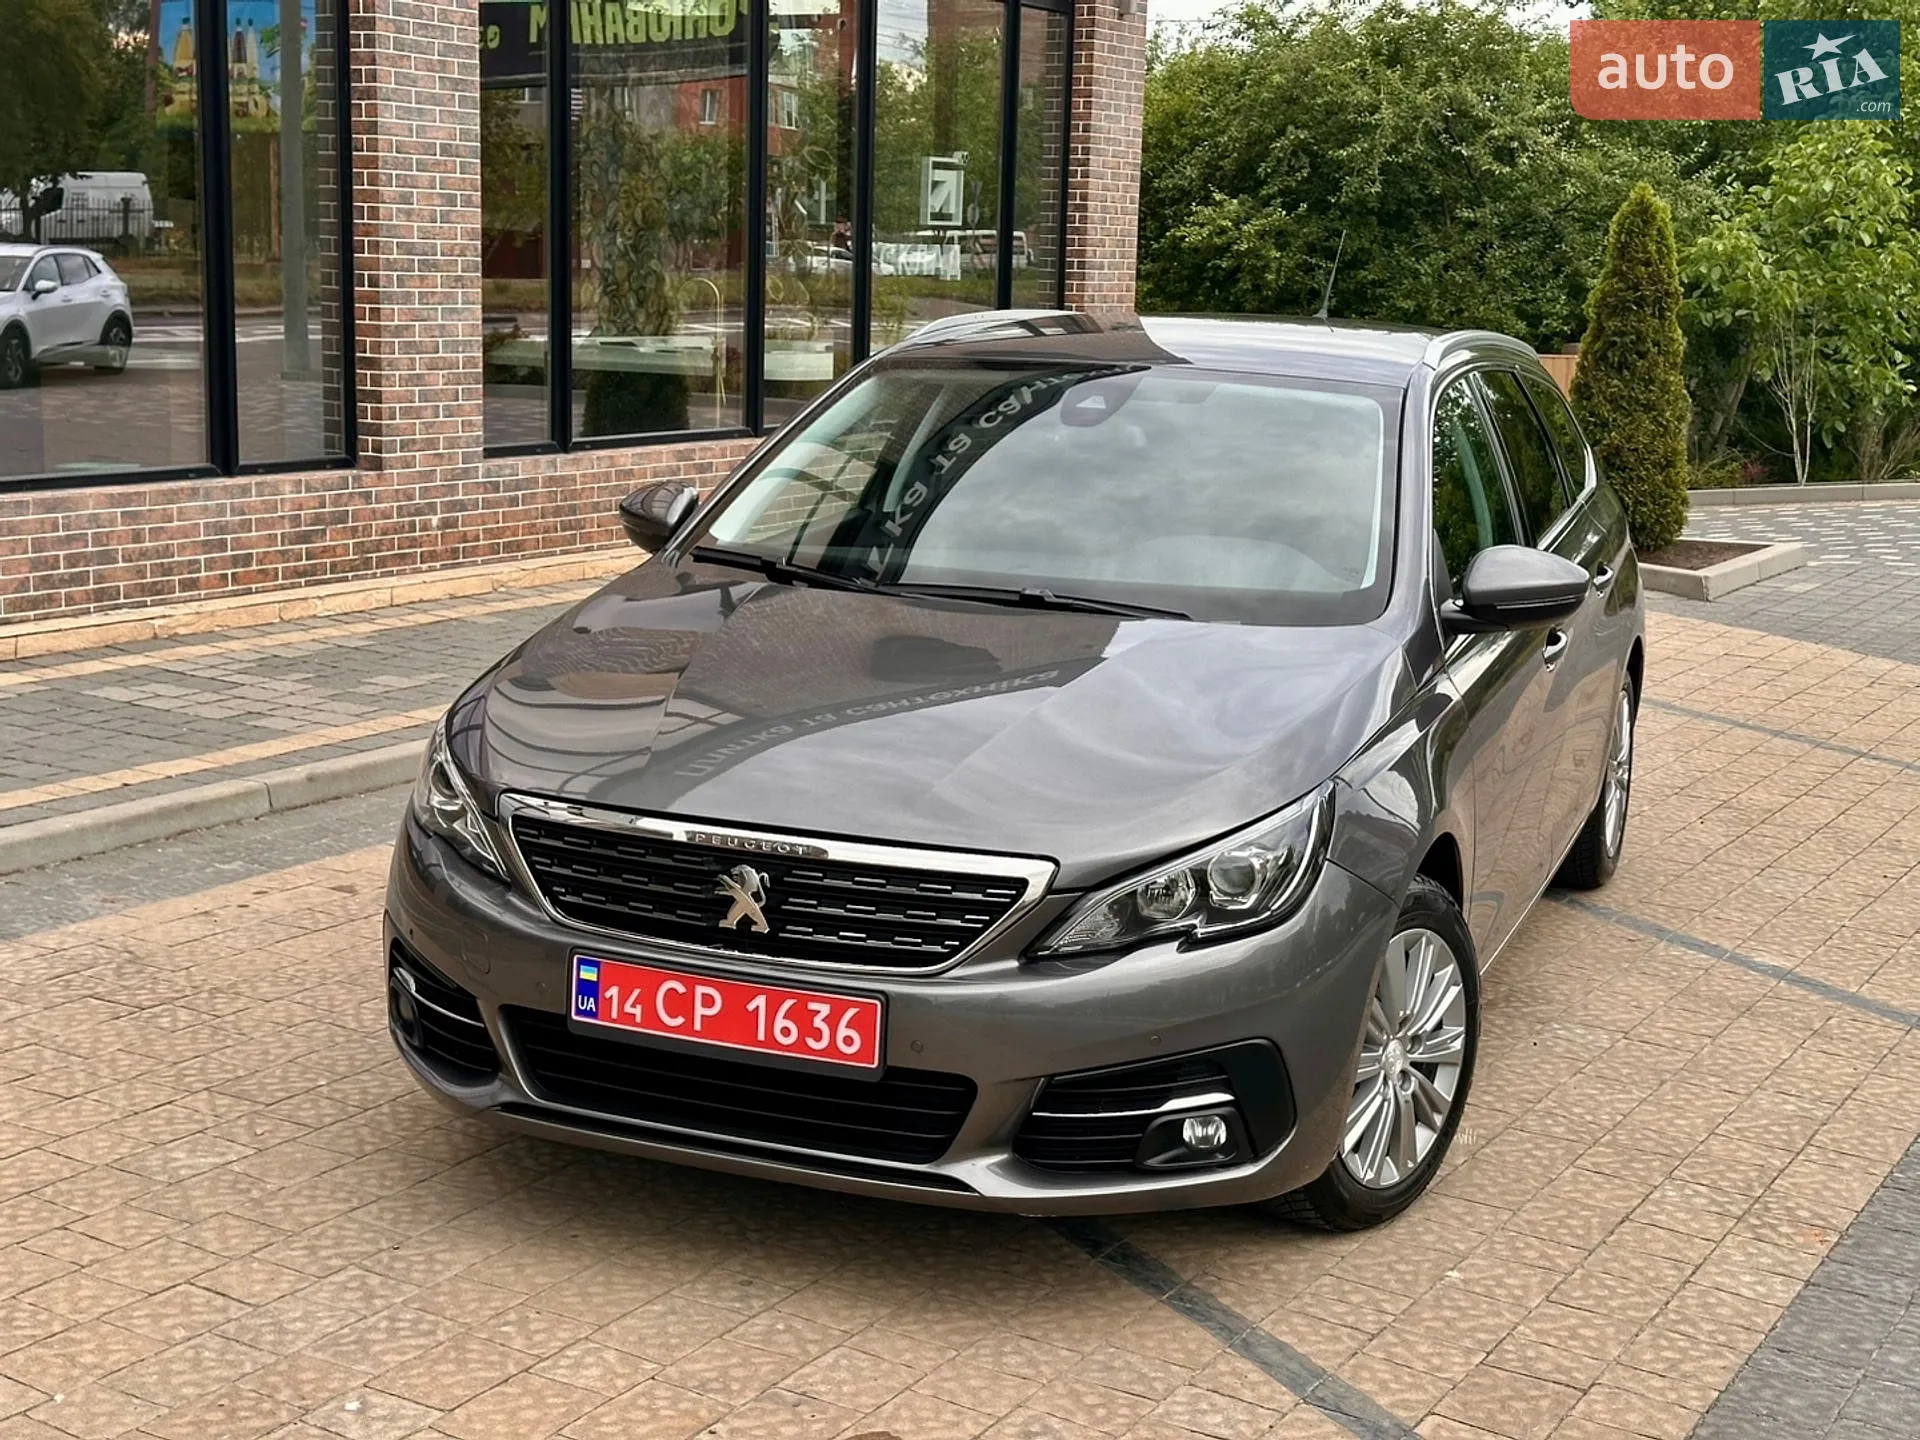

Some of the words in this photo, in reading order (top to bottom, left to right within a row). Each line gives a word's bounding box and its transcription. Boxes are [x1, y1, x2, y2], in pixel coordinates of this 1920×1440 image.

[695, 833, 808, 855] PEUGEOT
[577, 994, 597, 1013] UA
[604, 984, 643, 1024] 14
[655, 979, 723, 1032] CP
[745, 993, 862, 1055] 1636
